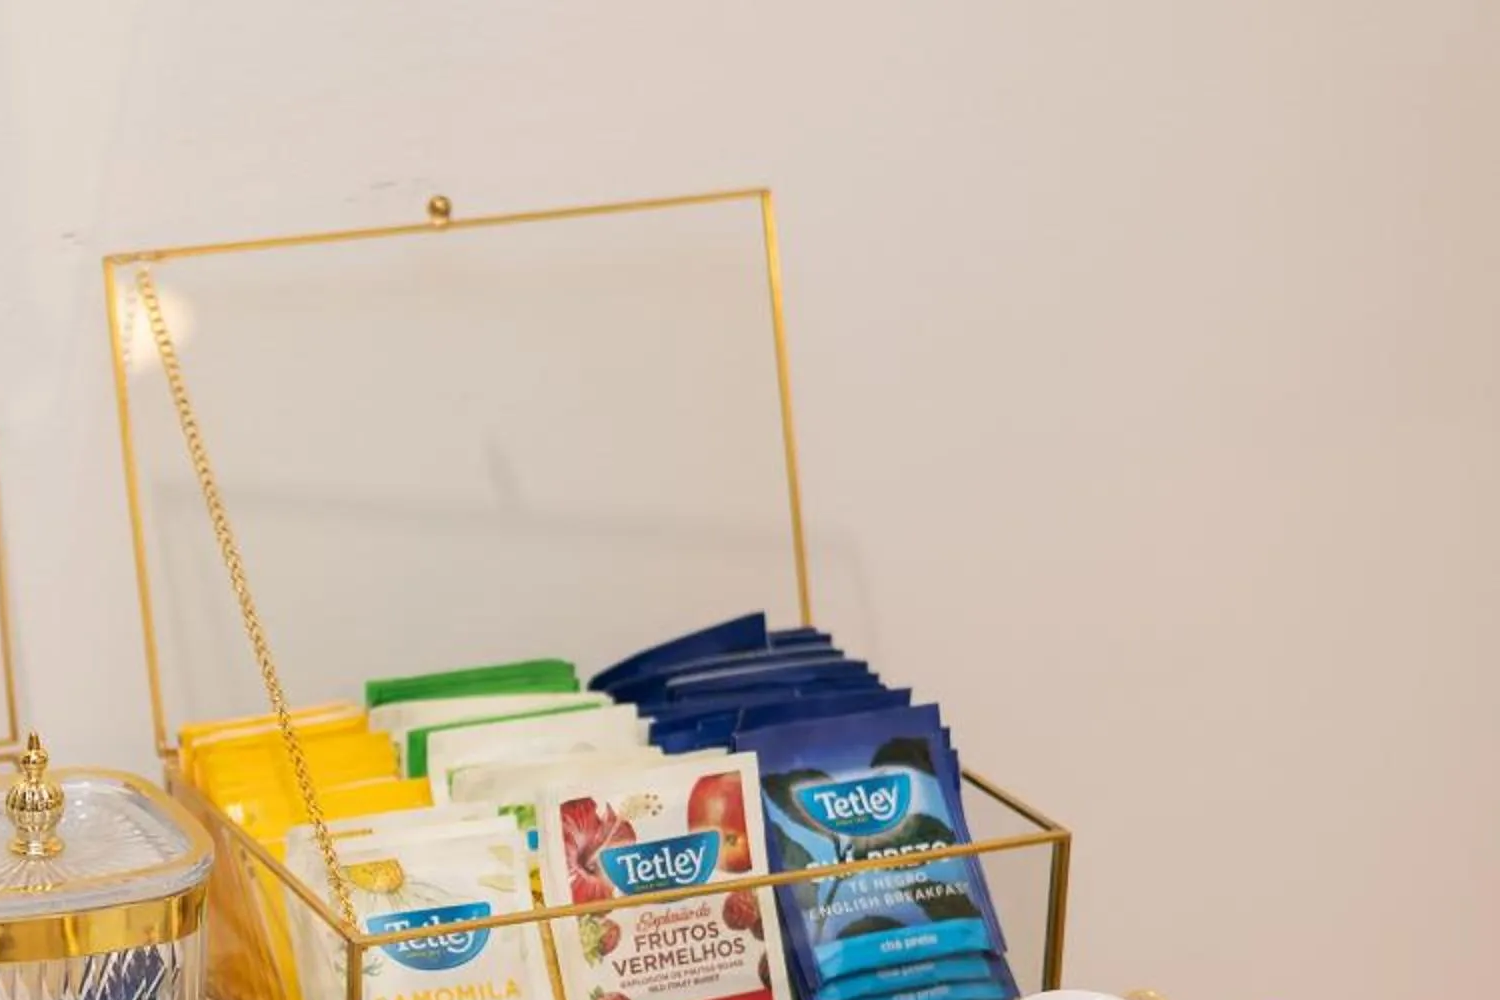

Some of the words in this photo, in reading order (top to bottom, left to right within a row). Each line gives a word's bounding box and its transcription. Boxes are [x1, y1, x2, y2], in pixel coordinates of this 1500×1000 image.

[814, 784, 897, 820] Tetley
[617, 845, 706, 884] Tetley
[874, 872, 927, 890] NEGRO
[810, 895, 880, 919] ENGLISH
[634, 922, 719, 952] FRUTOS
[613, 938, 745, 976] VERMELHOS
